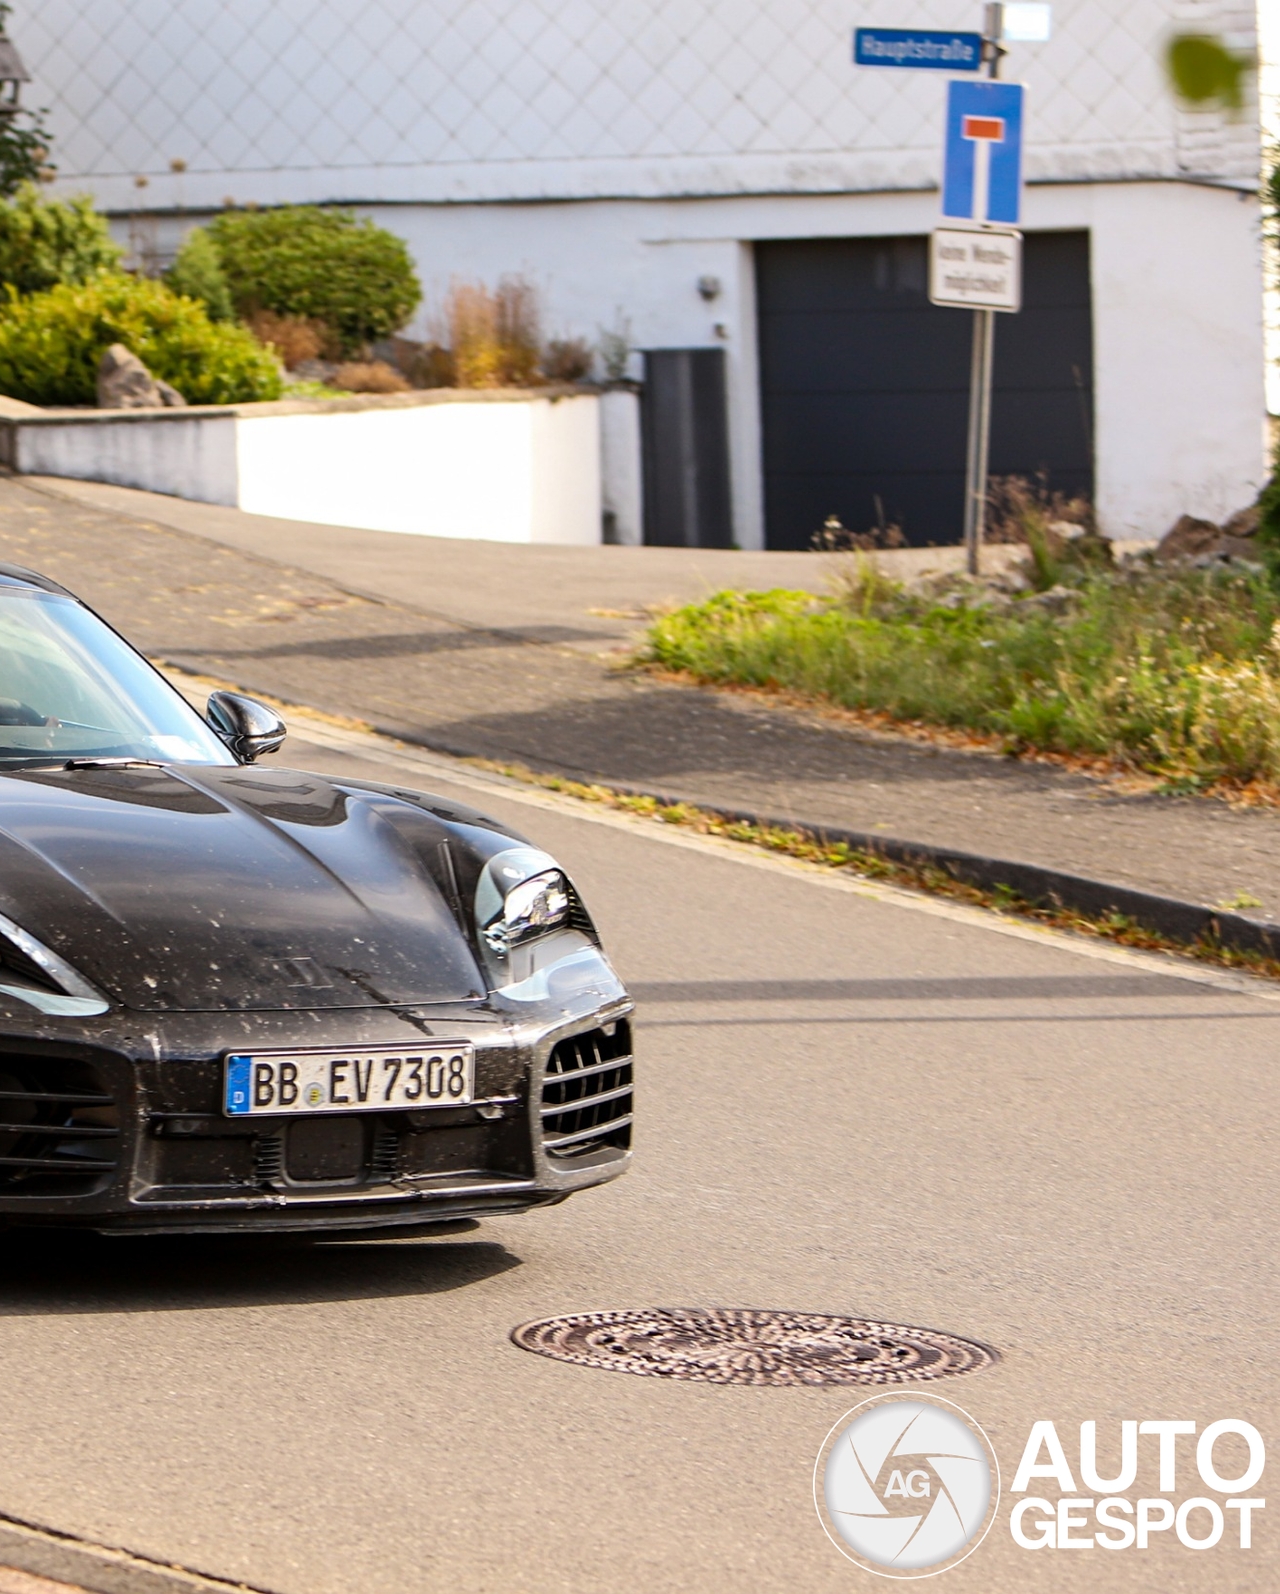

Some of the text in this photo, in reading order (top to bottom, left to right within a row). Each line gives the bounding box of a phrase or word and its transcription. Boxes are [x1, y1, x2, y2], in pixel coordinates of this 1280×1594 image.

[861, 35, 973, 64] Hauptstraße
[233, 1091, 245, 1104] D
[254, 1062, 299, 1107] BB
